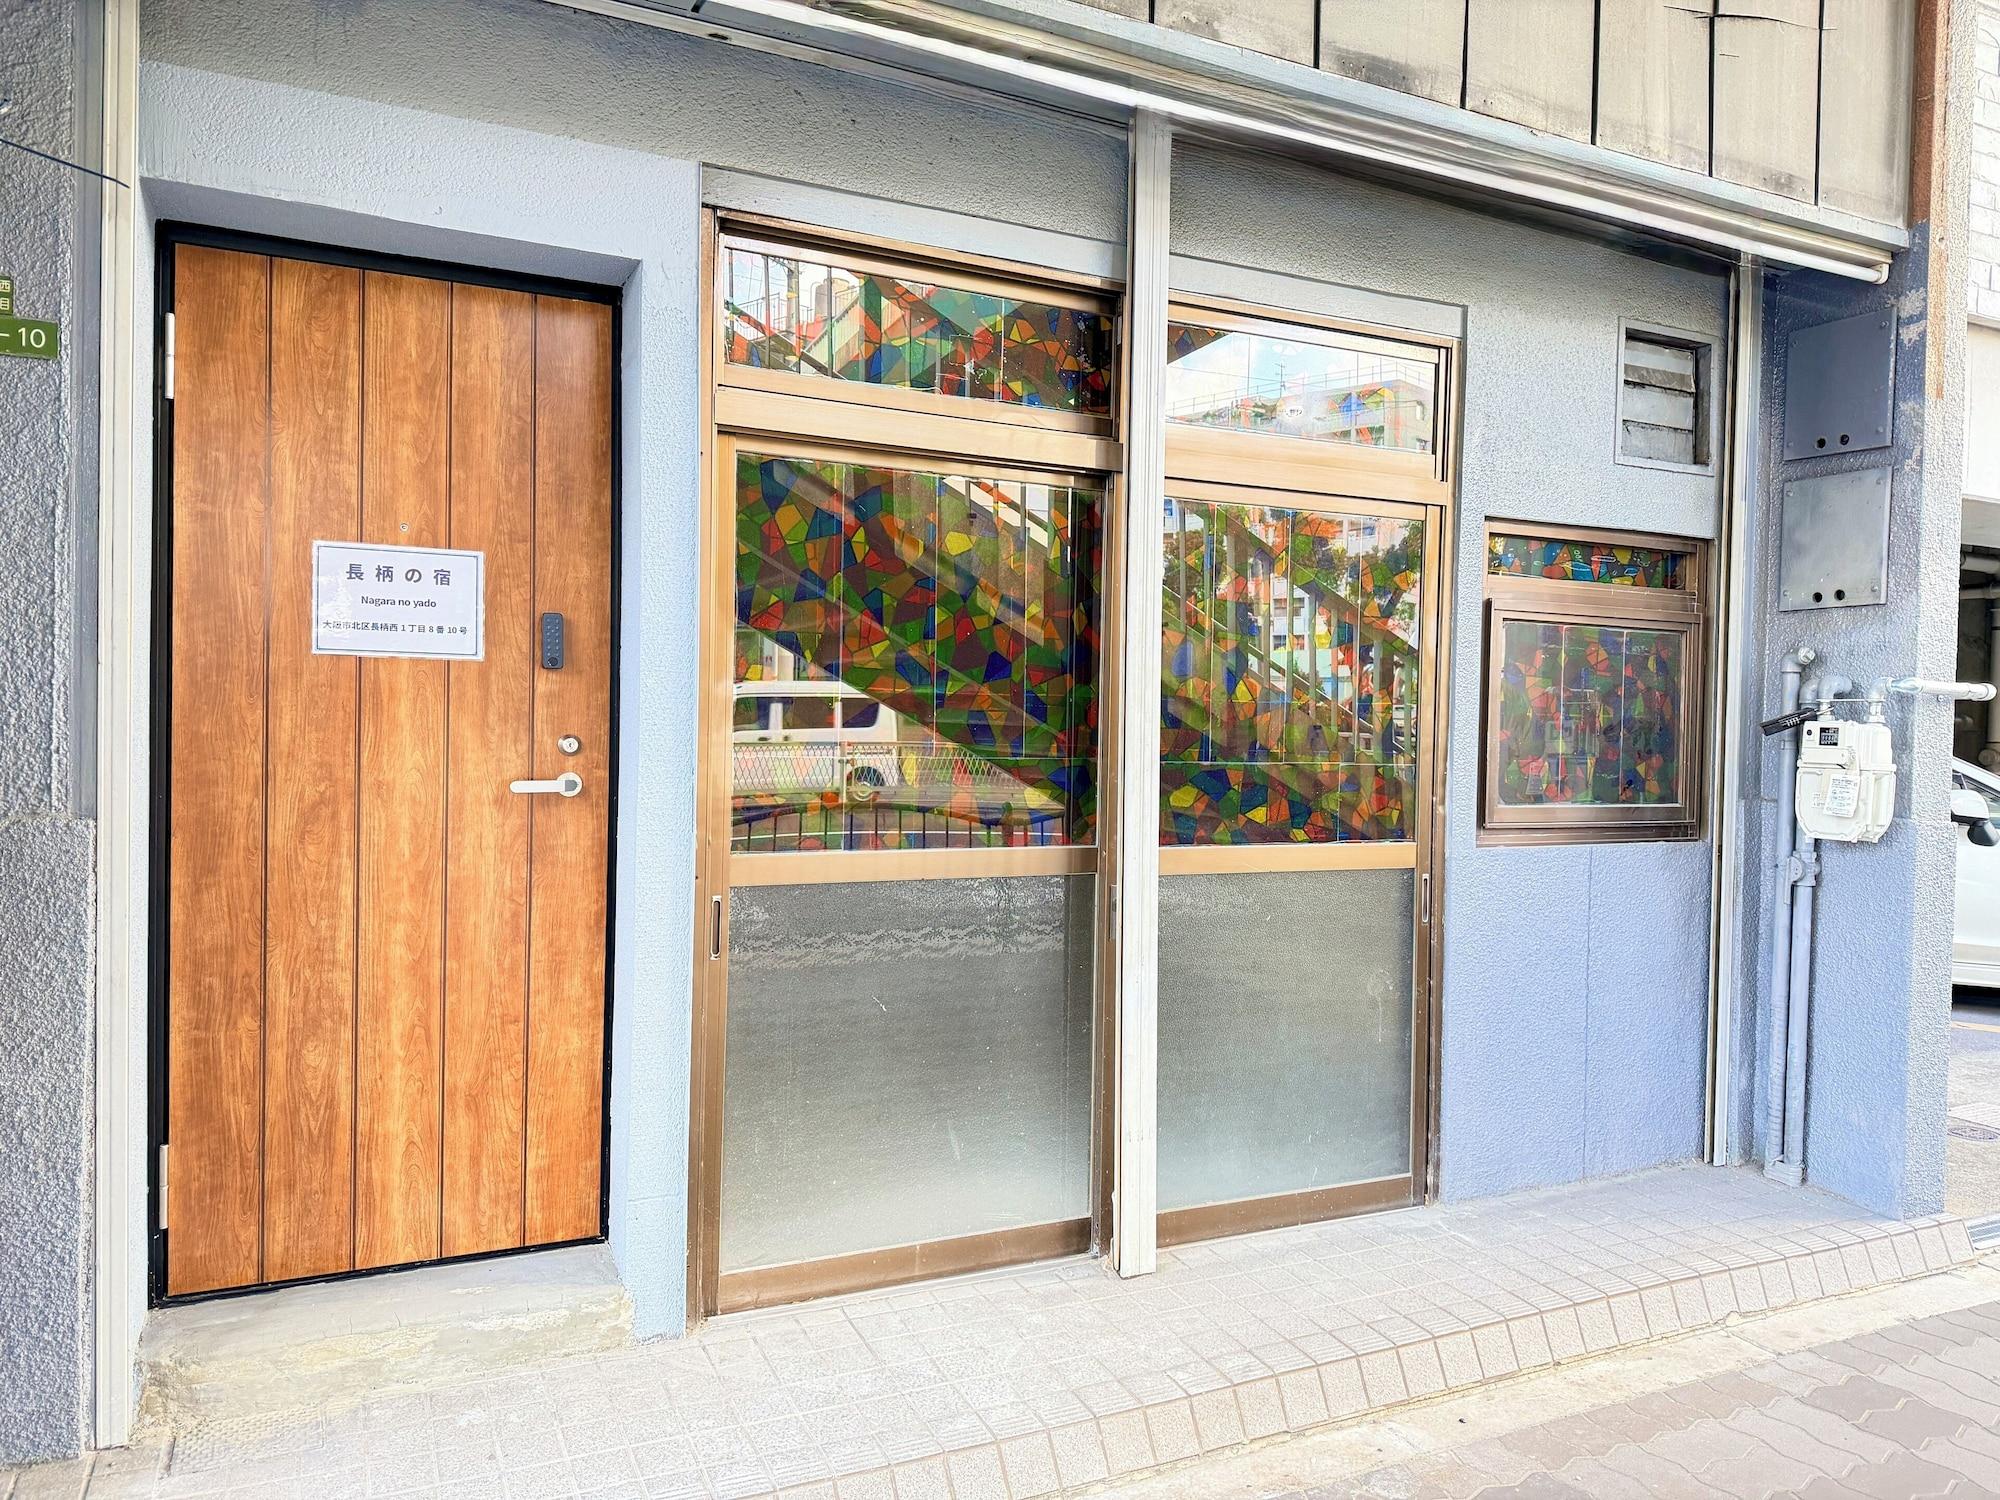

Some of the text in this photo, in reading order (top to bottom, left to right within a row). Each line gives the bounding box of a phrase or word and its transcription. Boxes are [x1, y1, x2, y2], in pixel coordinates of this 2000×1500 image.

[346, 563, 451, 586] 長柄の宿
[360, 595, 437, 609] Nagara no yado
